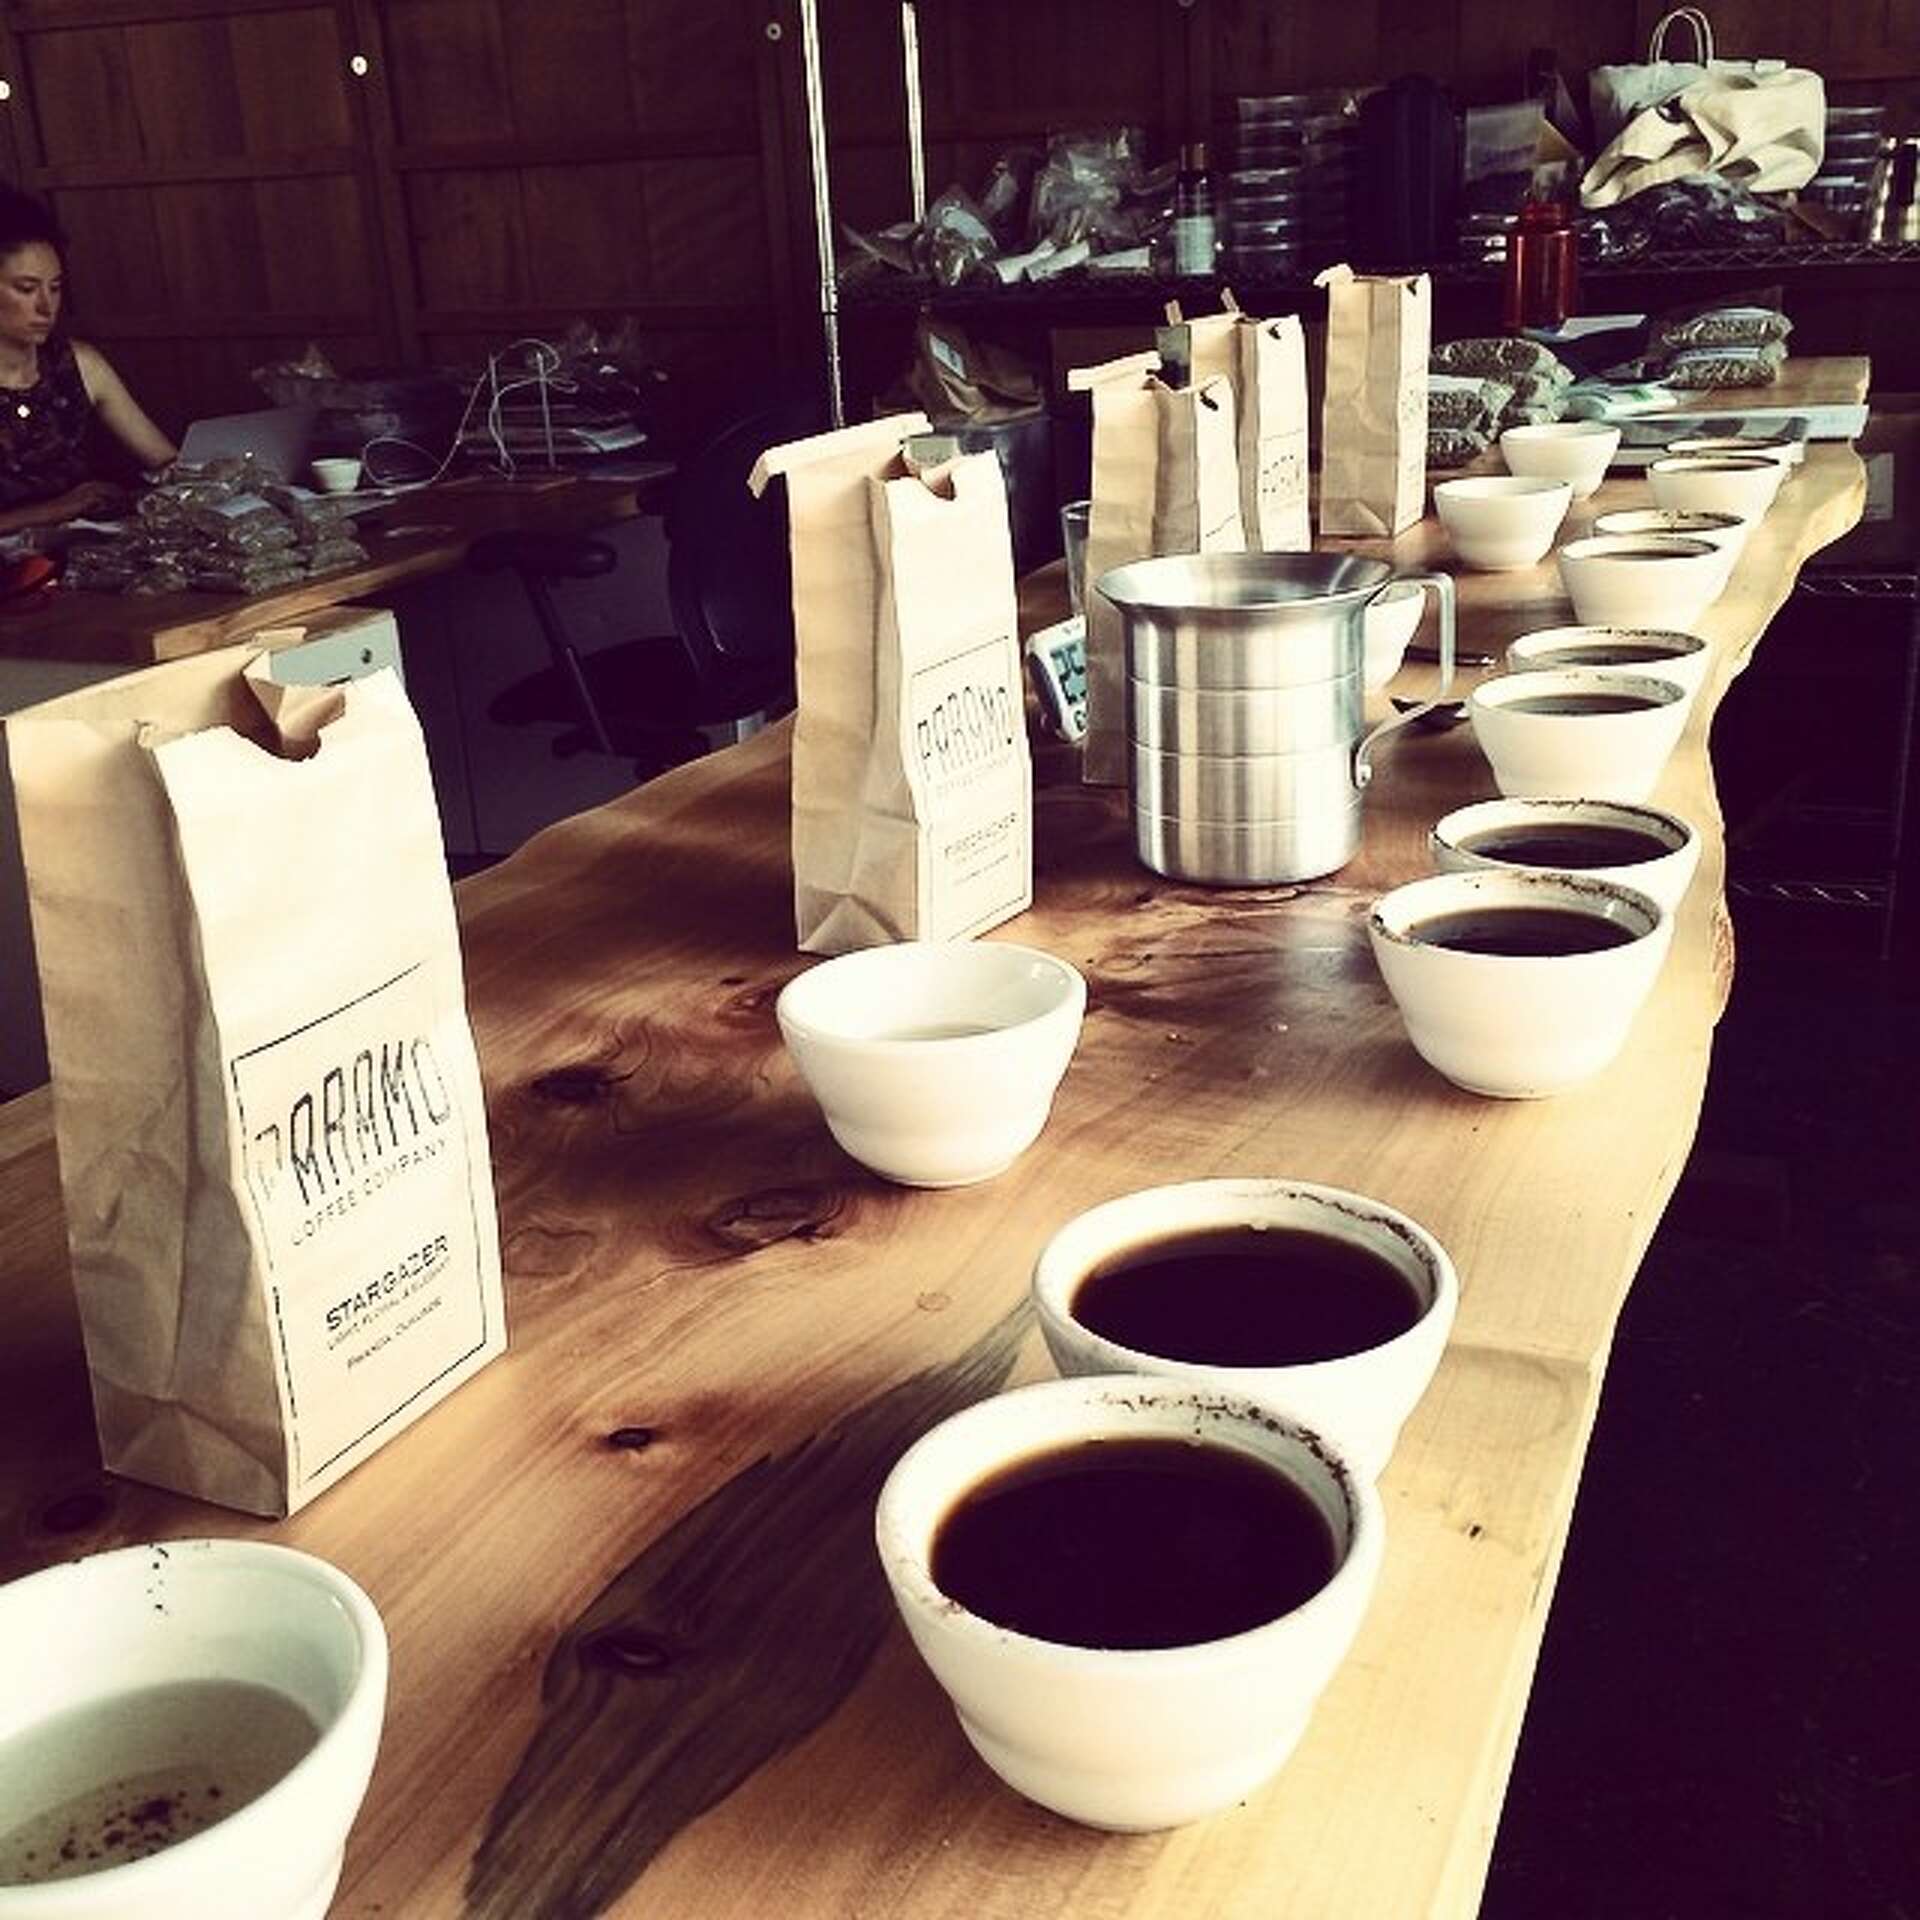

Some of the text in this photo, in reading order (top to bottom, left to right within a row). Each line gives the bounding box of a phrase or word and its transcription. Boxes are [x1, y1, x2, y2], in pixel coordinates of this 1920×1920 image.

[254, 1037, 451, 1206] PARAMO
[292, 1139, 446, 1246] COFFEE COMPANY
[326, 1234, 448, 1332] STARGAZER
